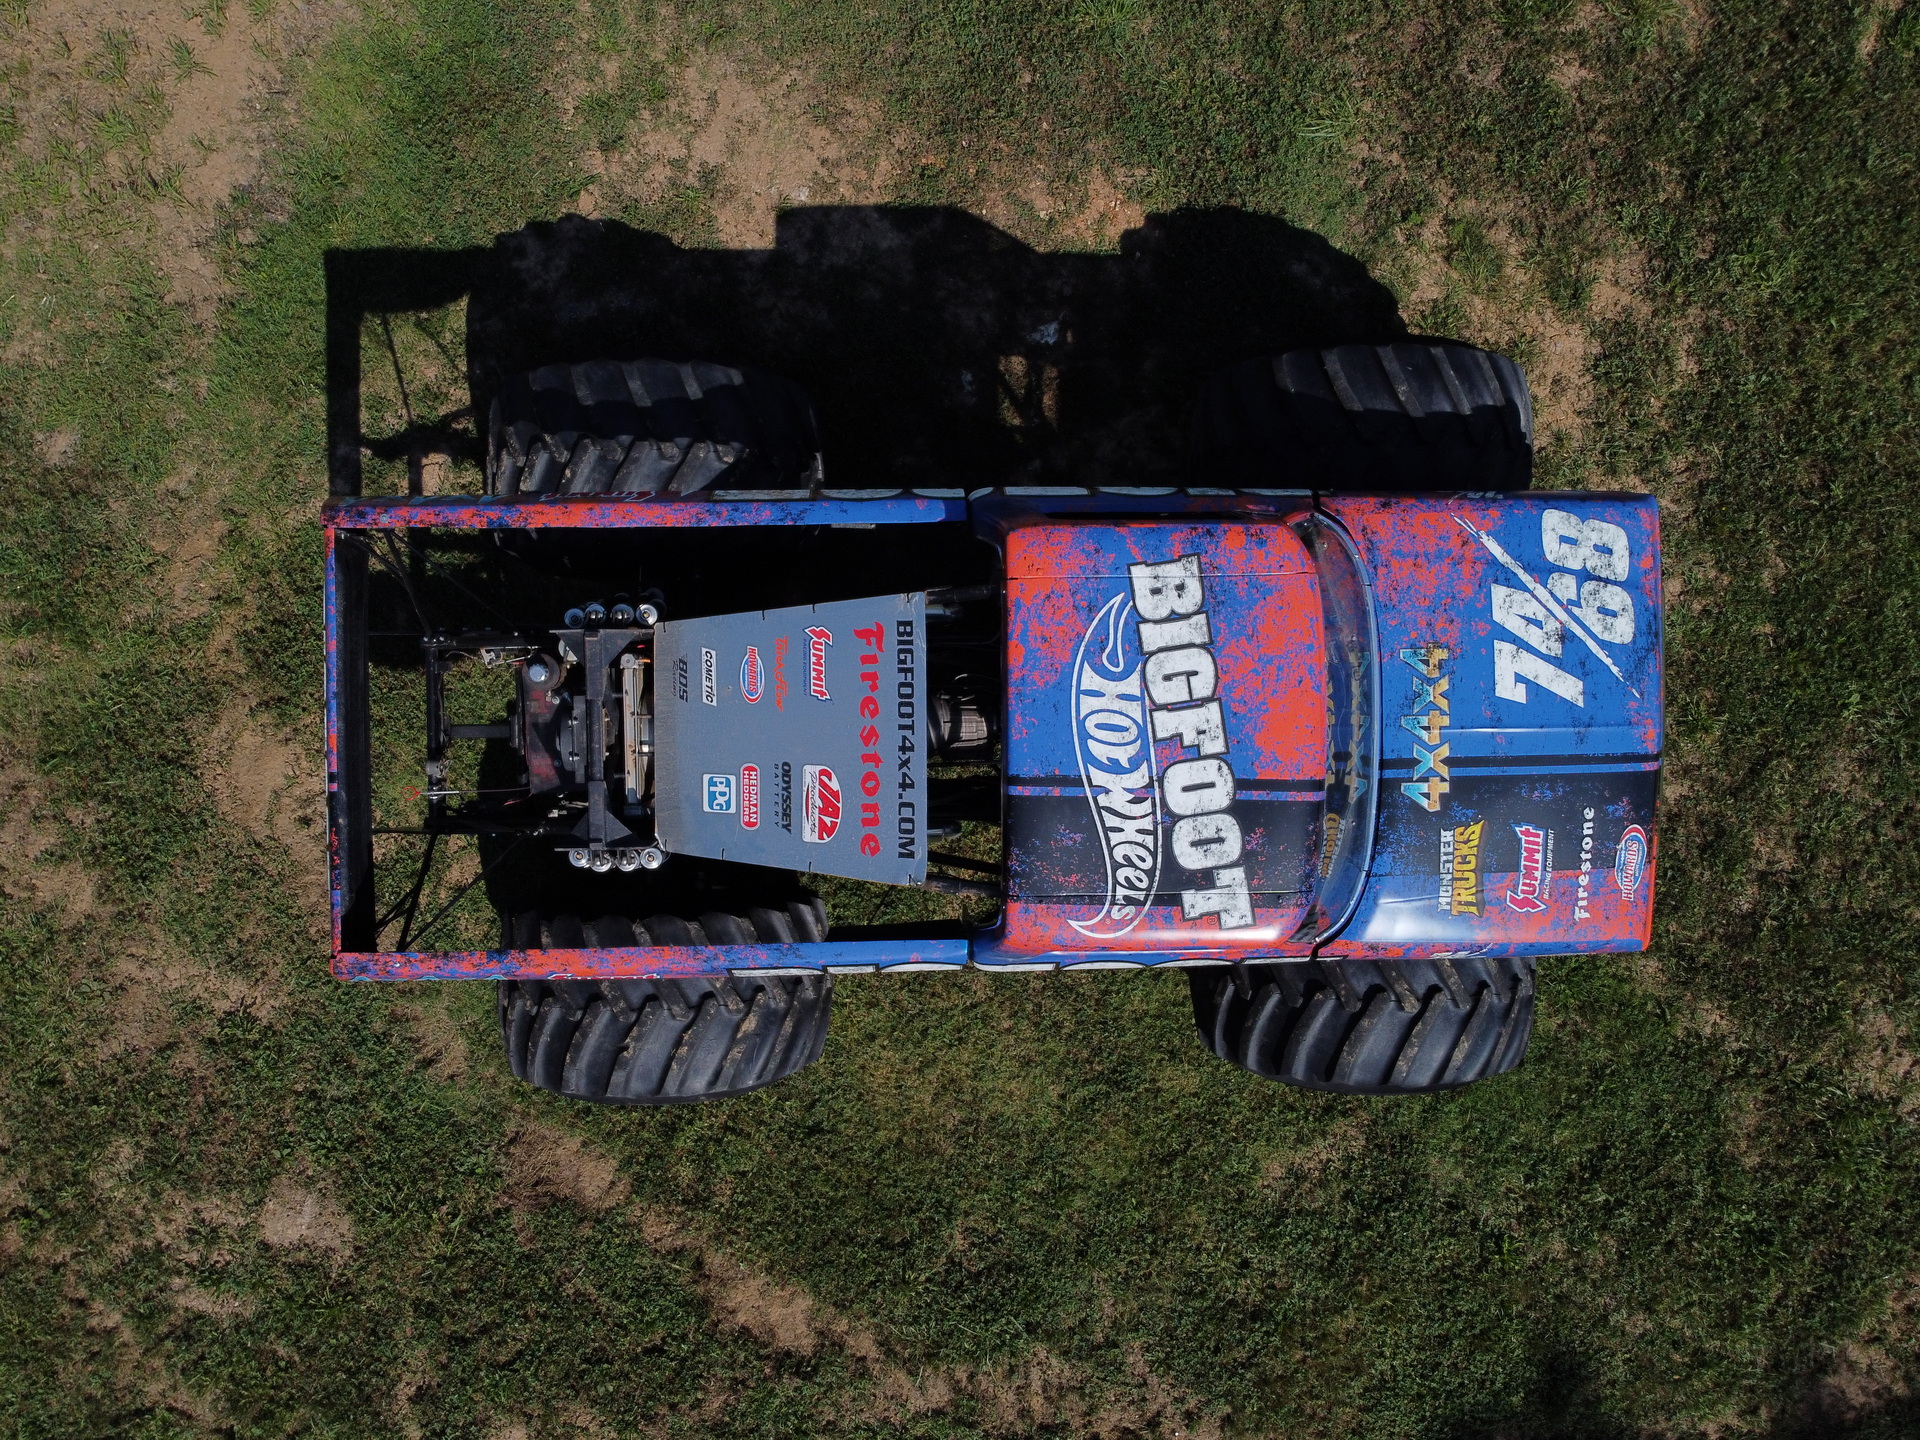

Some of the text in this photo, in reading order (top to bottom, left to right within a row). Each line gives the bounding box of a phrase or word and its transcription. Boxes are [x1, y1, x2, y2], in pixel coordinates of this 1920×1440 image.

[748, 646, 758, 694] HOWARDS
[853, 621, 885, 857] Firestone
[1127, 553, 1256, 930] BIGFOOT
[710, 777, 730, 810] PPG
[749, 771, 757, 823] HEDMAN
[780, 761, 792, 834] ODYSSEY
[818, 768, 841, 841] JAZ
[1079, 660, 1155, 921] Hot Wheels
[1438, 828, 1453, 912] MONSTER
[1451, 820, 1487, 917] TRUCKS
[1542, 828, 1555, 900] RACING EQUIPMENT
[1574, 806, 1595, 922] Firestone
[1621, 839, 1640, 901] HOWARDS
